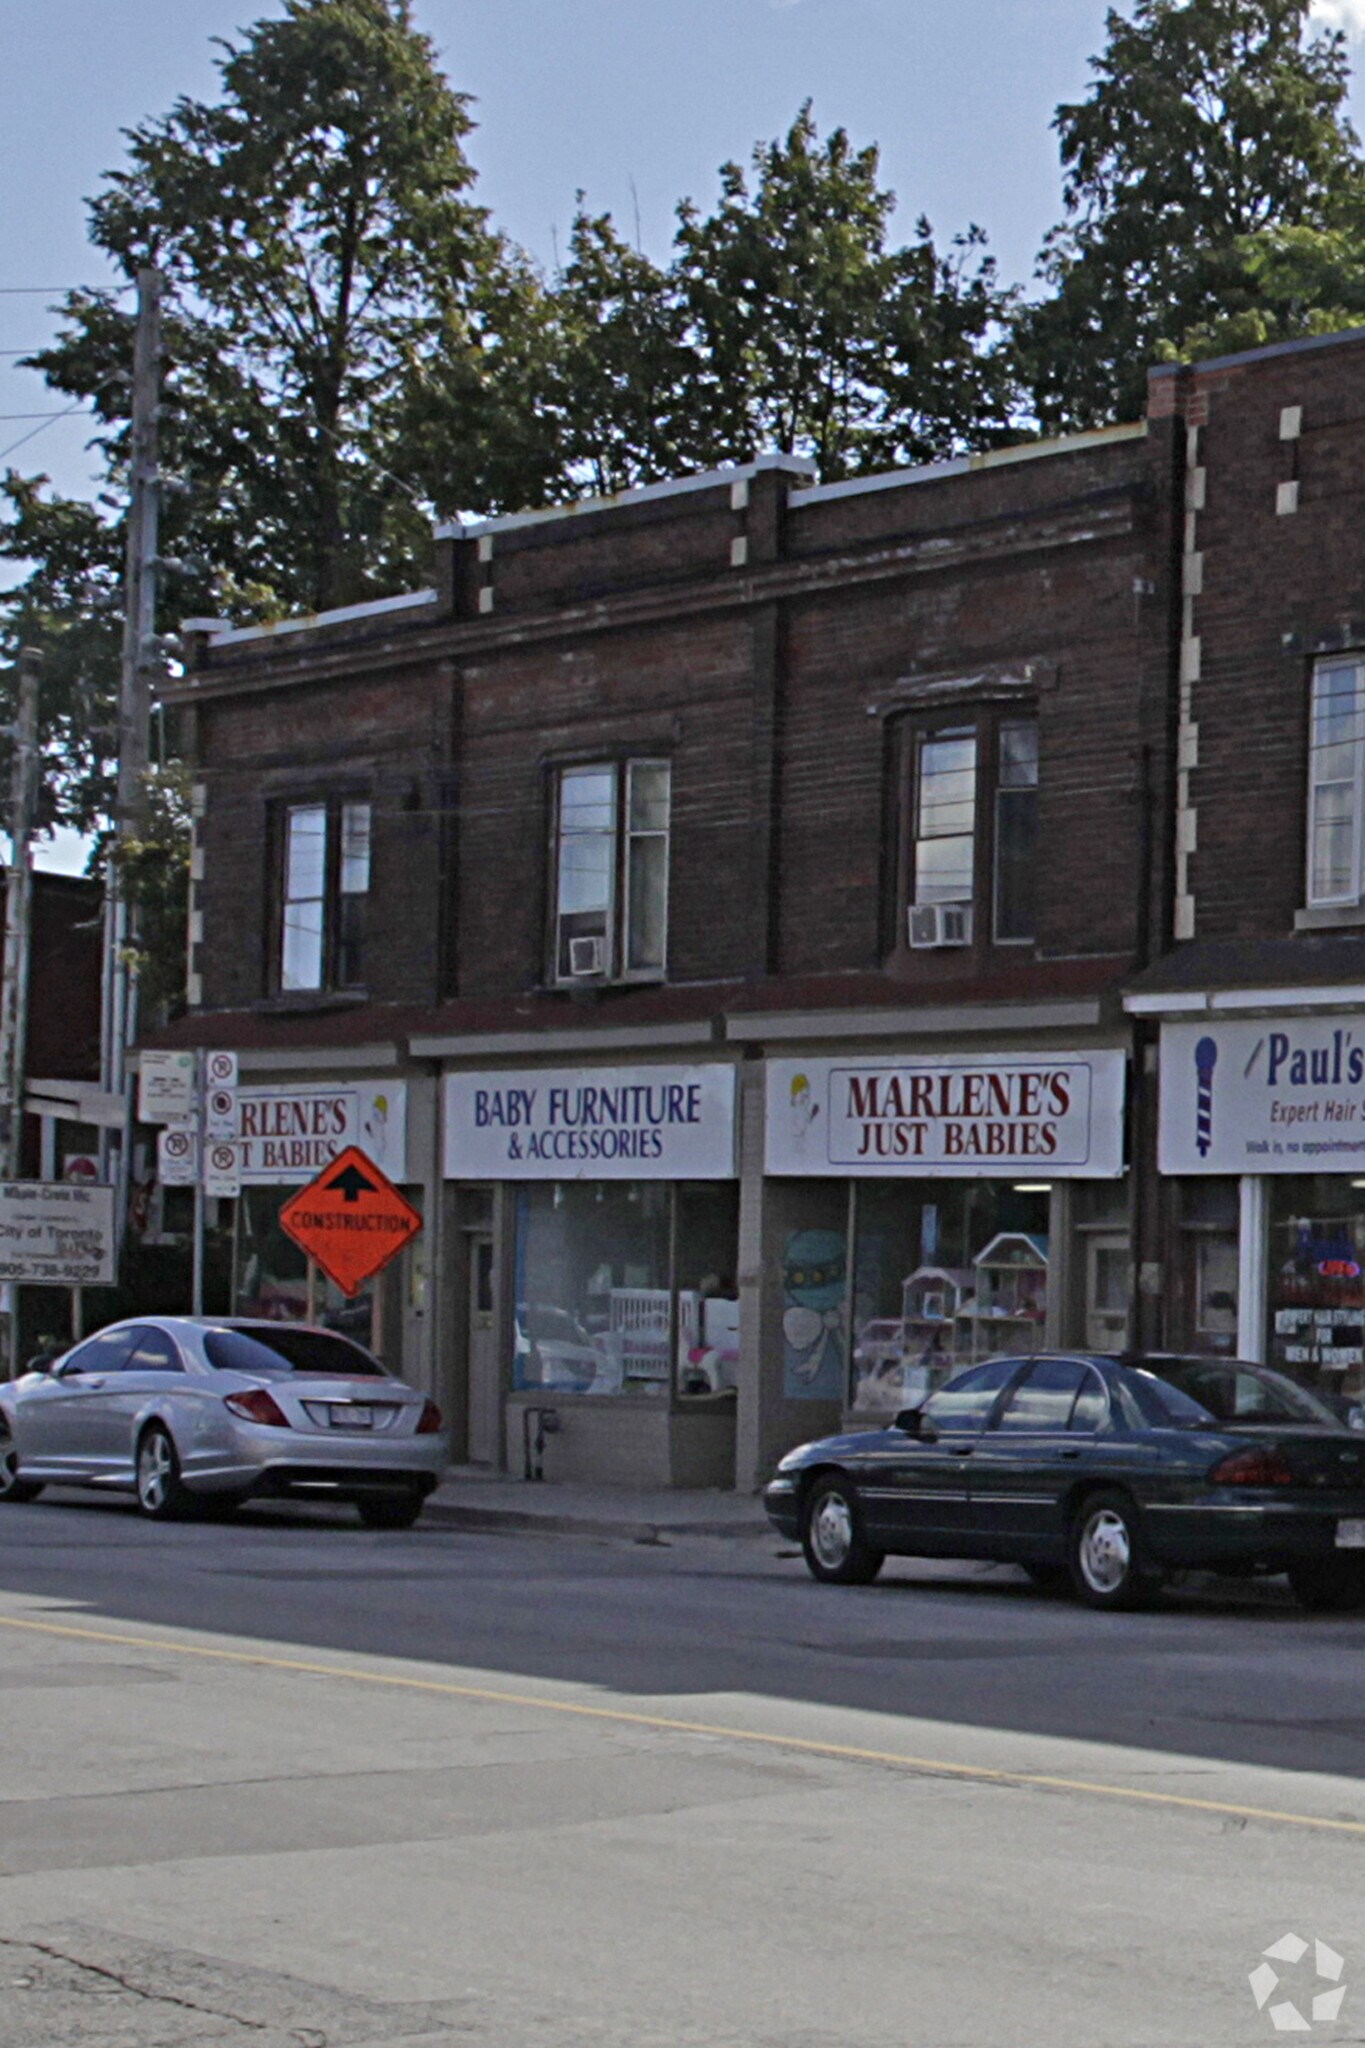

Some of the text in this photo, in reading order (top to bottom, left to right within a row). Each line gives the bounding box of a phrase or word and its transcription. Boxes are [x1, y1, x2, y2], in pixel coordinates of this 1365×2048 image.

[1267, 1030, 1364, 1085] Paul's
[475, 1084, 701, 1127] BABY FURNITURE
[847, 1071, 1070, 1118] MARLENE'S
[240, 1098, 346, 1137] RLENE'S
[1270, 1100, 1319, 1126] Expert
[1323, 1099, 1357, 1121] Hair
[508, 1128, 662, 1160] & ACCESSORIES
[857, 1122, 1057, 1155] JUST BABIES
[47, 1225, 103, 1242] Toronto
[290, 1211, 411, 1233] CONSTRUCTION
